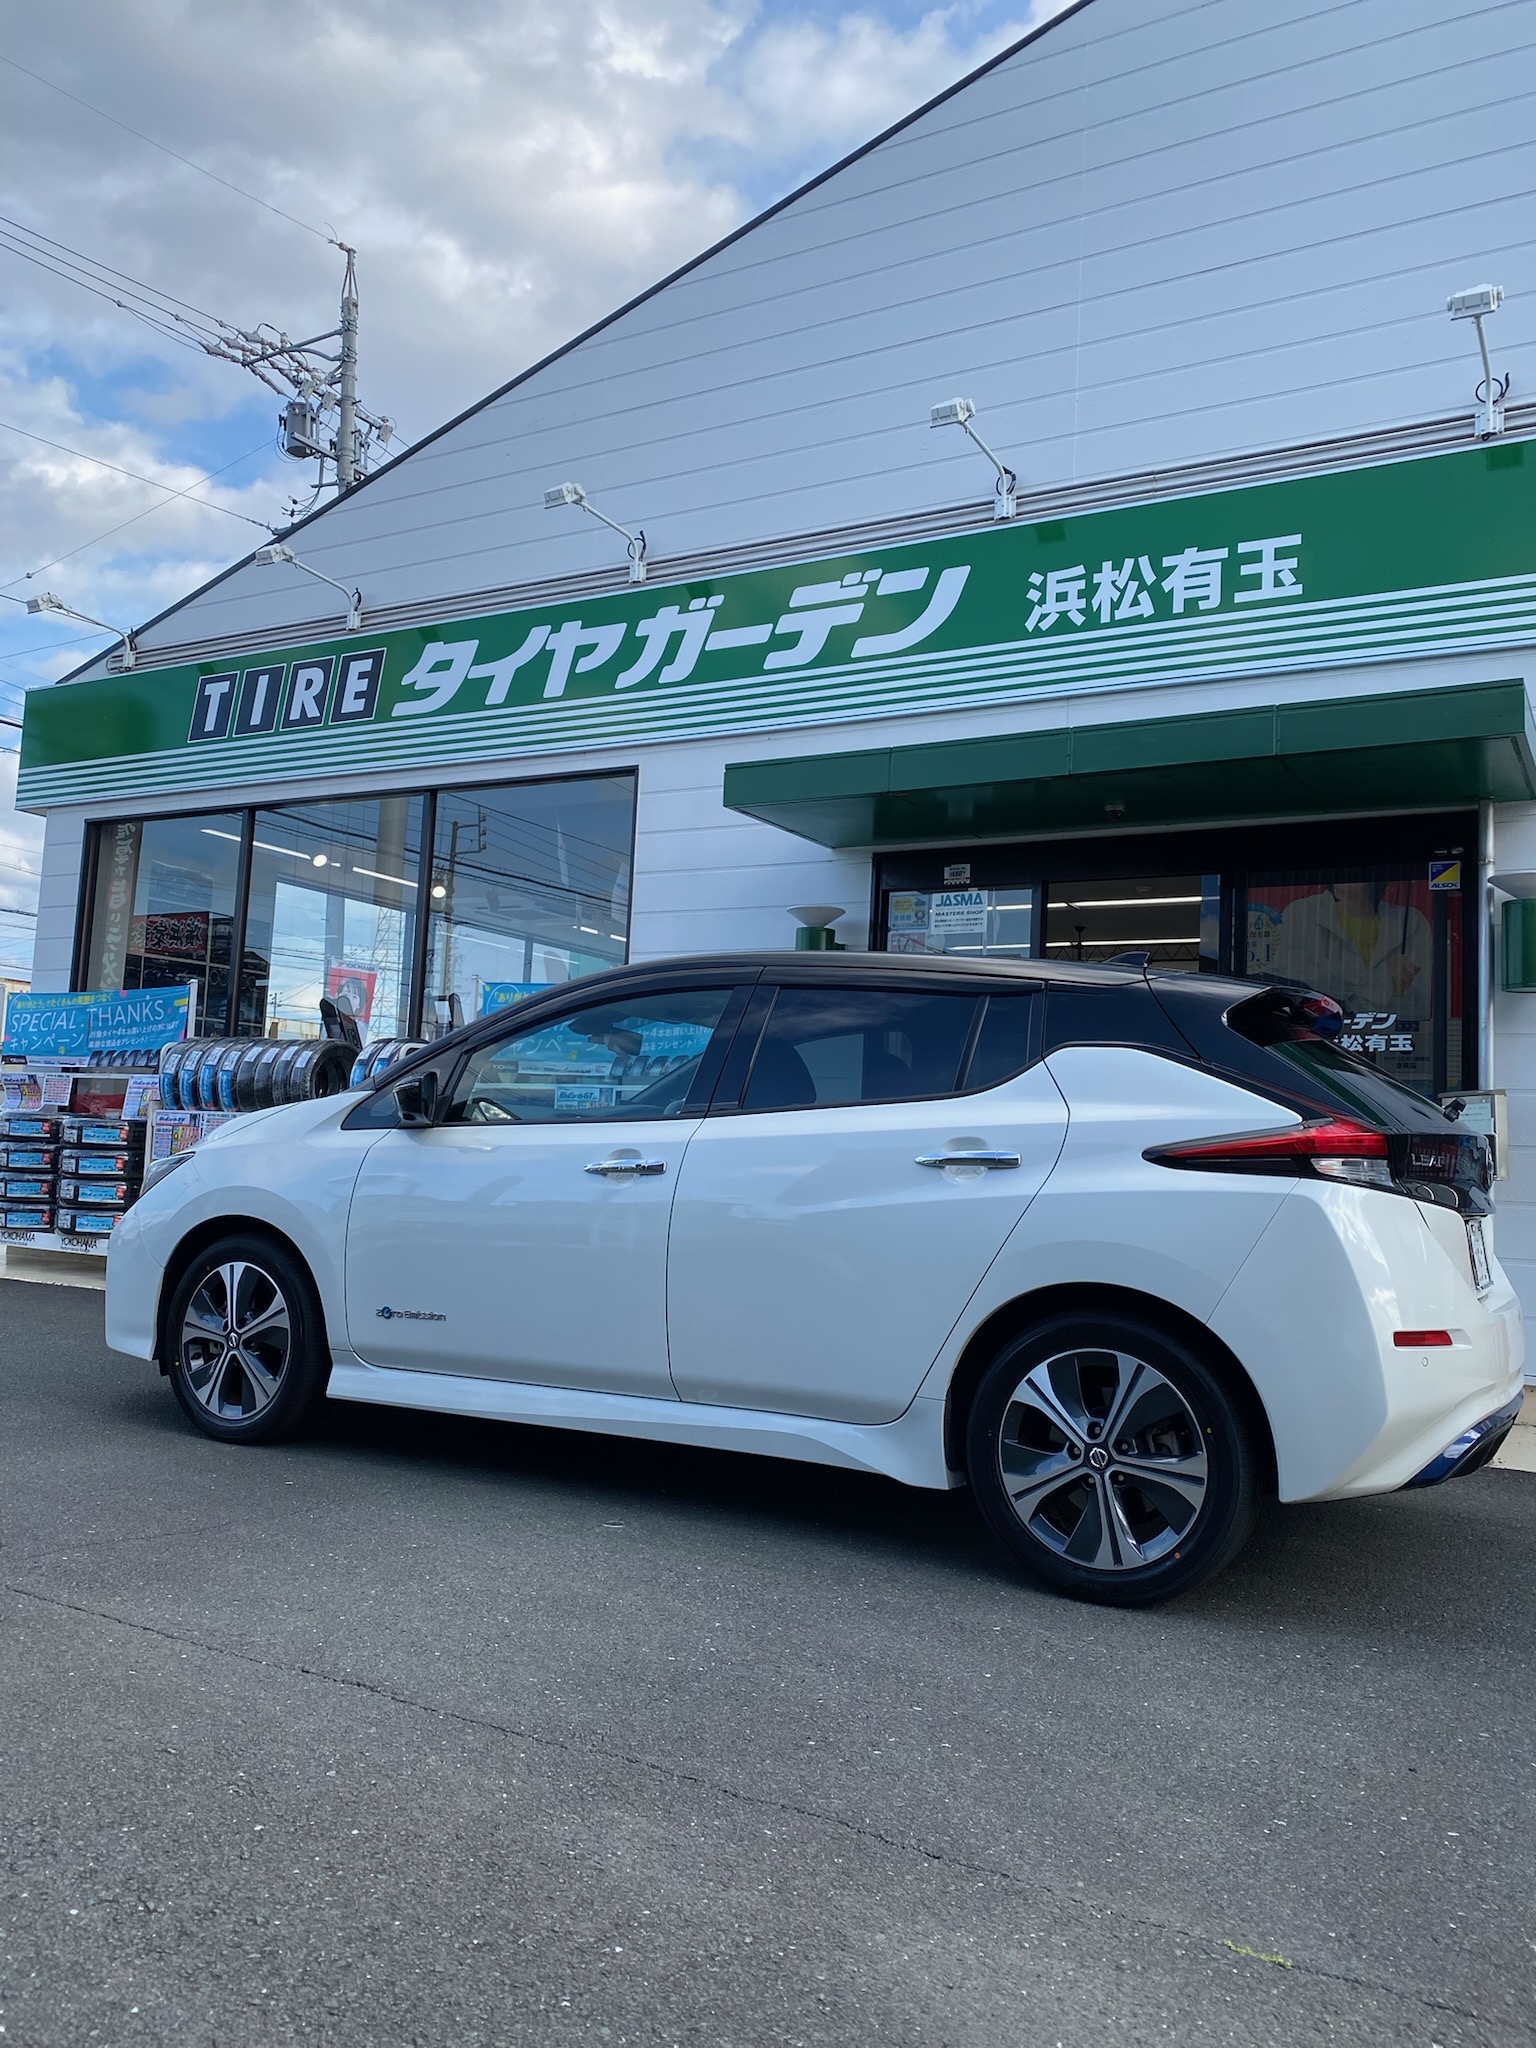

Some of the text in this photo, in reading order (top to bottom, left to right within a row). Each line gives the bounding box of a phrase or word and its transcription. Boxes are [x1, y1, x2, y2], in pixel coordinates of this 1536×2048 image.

[204, 534, 1303, 732] TIRE タイヤガーデン 浜松有玉
[936, 893, 983, 907] JASMA
[346, 963, 375, 972] YOKOHAMA
[11, 1000, 165, 1033] SPECIAL THANKS
[10, 1033, 84, 1051] キャンペーン
[1334, 1034, 1414, 1053] 松有玉
[1411, 1153, 1447, 1168] LEAF
[0, 1231, 36, 1242] YOKOHAMA
[61, 1237, 98, 1249] YOKOHAMA
